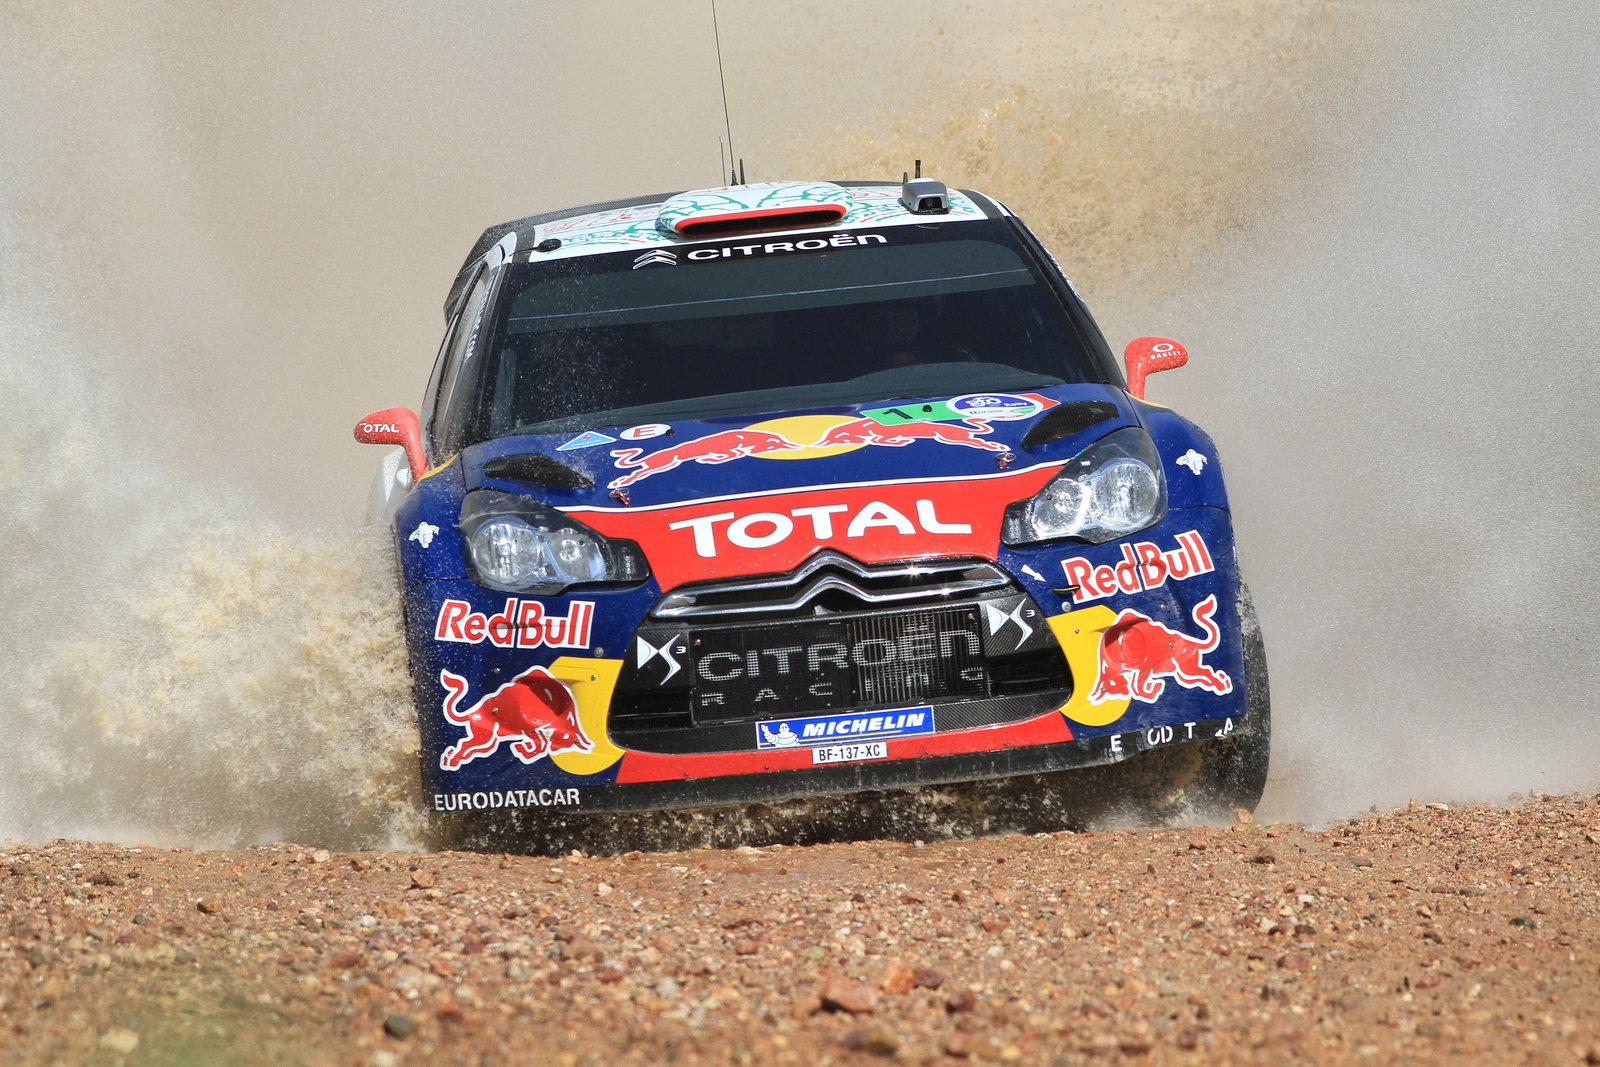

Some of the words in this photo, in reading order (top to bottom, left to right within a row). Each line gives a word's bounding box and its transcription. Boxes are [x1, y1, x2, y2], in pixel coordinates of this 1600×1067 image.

[1149, 350, 1181, 360] OAKLEY
[882, 408, 914, 420] 1
[632, 425, 657, 438] E
[669, 499, 973, 558] TOTAL
[802, 712, 926, 738] MICHELIN
[819, 744, 881, 761] BF-137-XC
[434, 787, 581, 811] EURODATACAR
